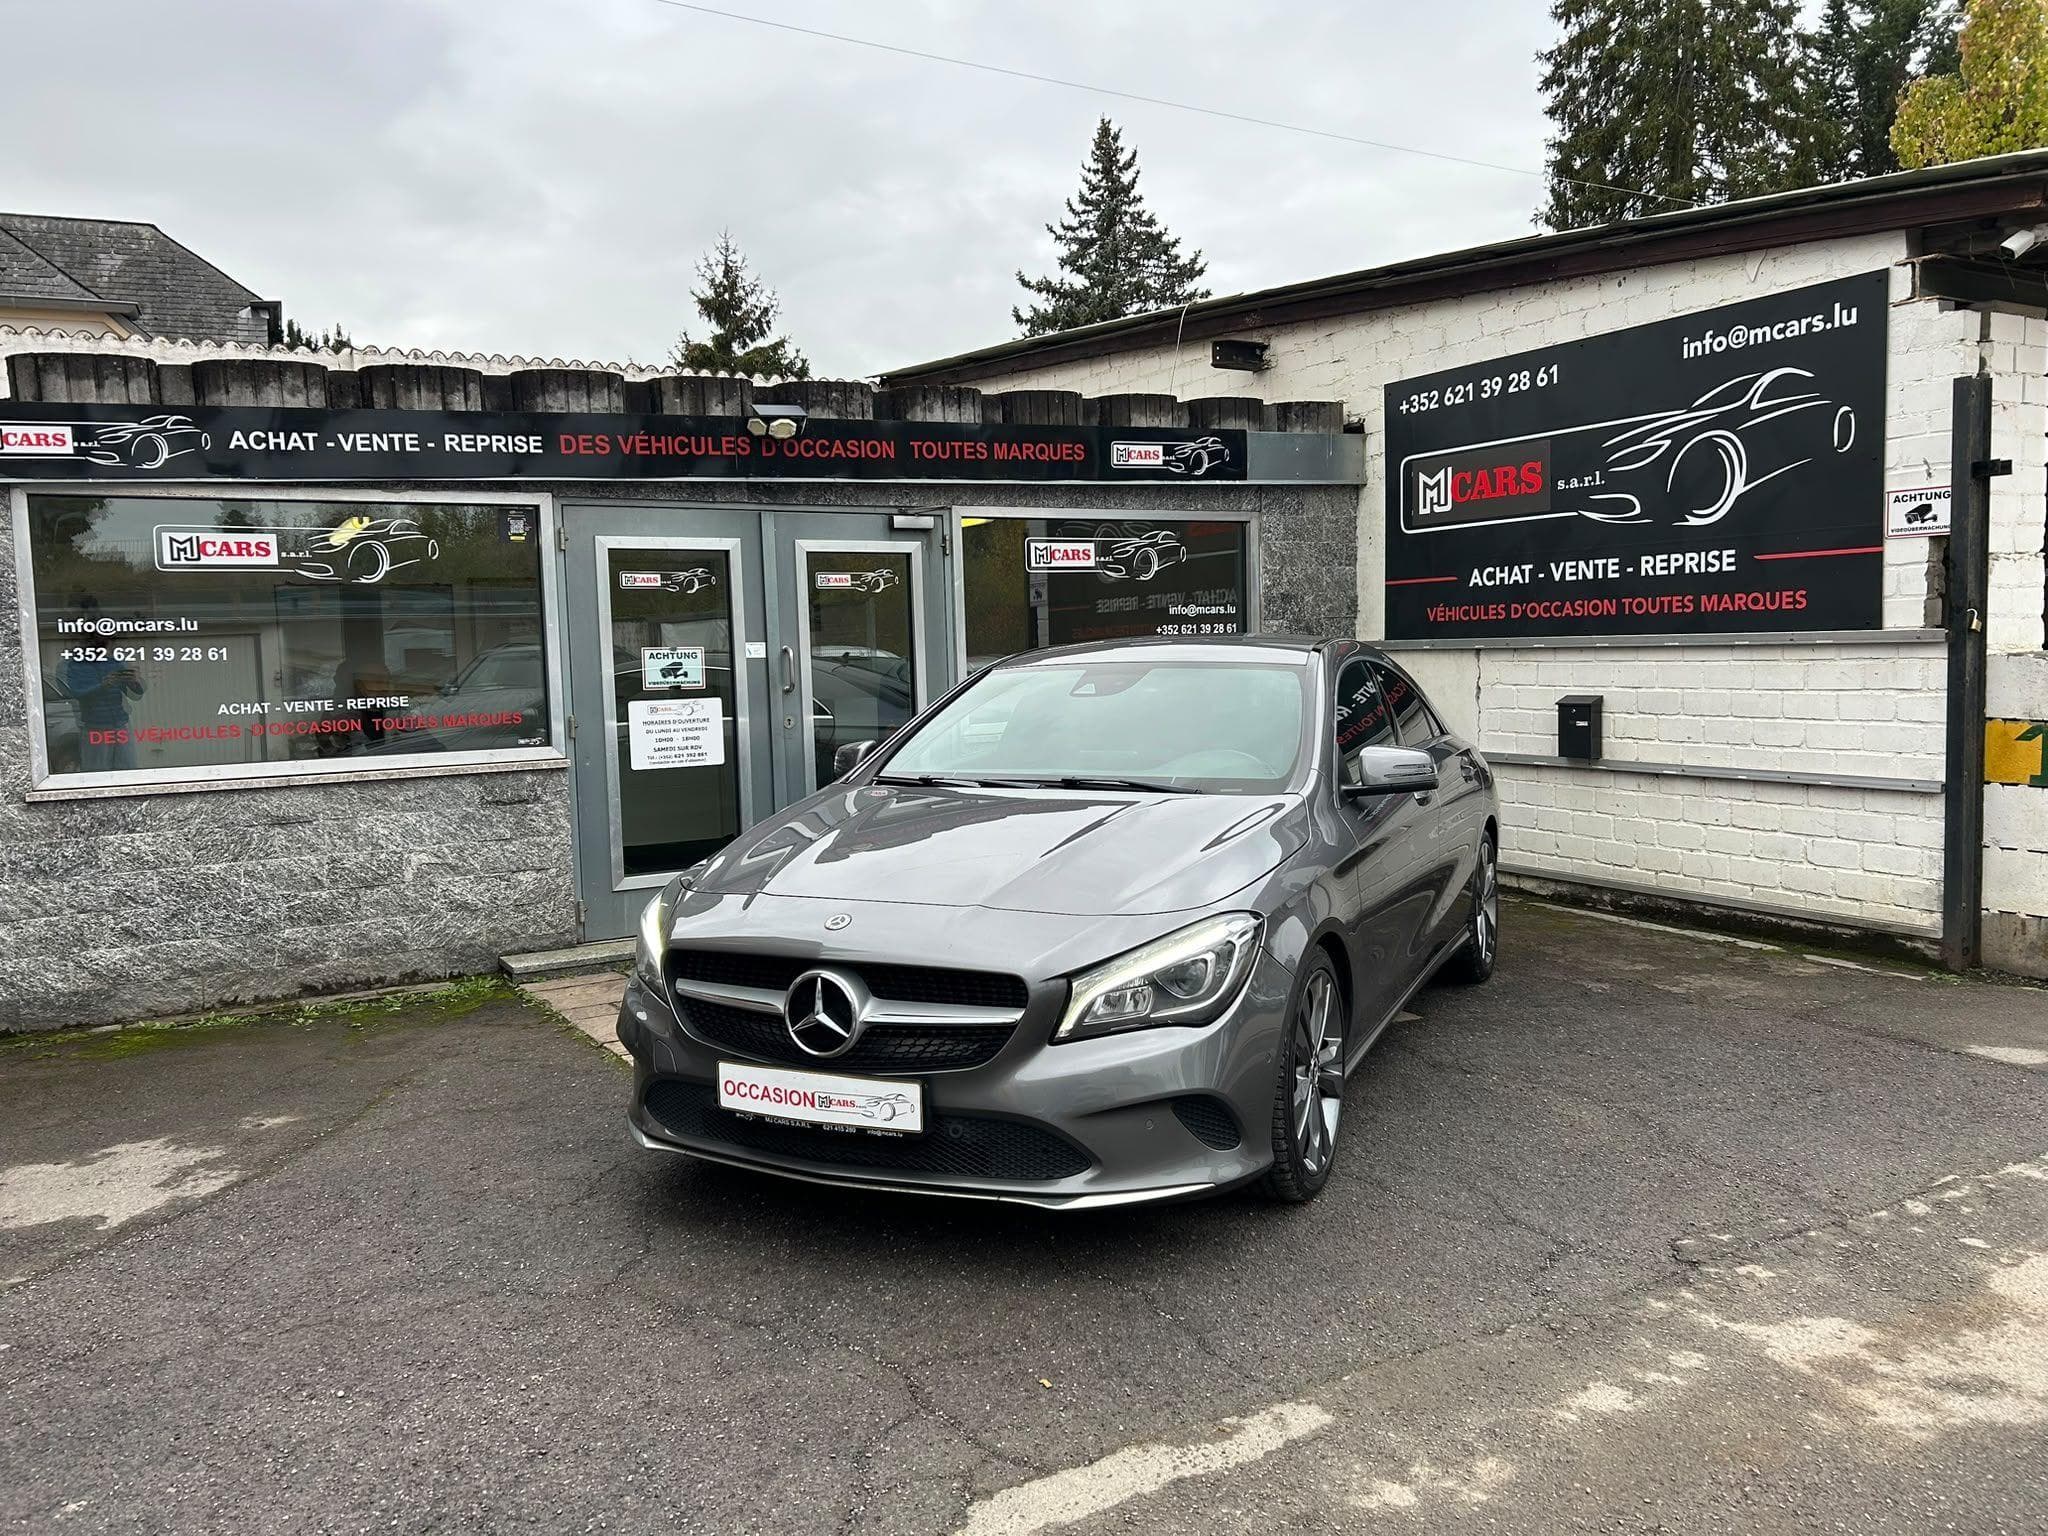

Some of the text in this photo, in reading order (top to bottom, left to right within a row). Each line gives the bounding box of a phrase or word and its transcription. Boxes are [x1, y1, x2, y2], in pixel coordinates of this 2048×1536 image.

[1682, 302, 1858, 359] info@mcars.lu
[1400, 364, 1558, 414] +352 621 39 28 61
[228, 430, 319, 451] ACHAT
[337, 433, 421, 452] VENTE
[444, 434, 543, 453] REPRISE
[559, 434, 611, 455] DES
[616, 431, 750, 456] VÉHICULES
[761, 439, 895, 458] D'OCCASION
[909, 441, 988, 459] TOUTES
[993, 442, 1085, 461] MARQUES
[1557, 471, 1606, 490] s.a.r.l.
[1893, 490, 1951, 503] ACHTUNG
[281, 550, 313, 558] s.a.r.l.
[1469, 564, 1533, 587] ACHAT
[1550, 558, 1620, 582] VENTE
[1640, 549, 1737, 577] REPRISE
[1169, 604, 1236, 617] info@mcars.lu
[1427, 590, 1807, 622] VÉHICULES D'OCCASION TOUTES MARQUES
[57, 617, 199, 636] info@mcars.lu
[1156, 624, 1178, 635] +352
[1181, 624, 1197, 635] 621
[1200, 624, 1211, 634] 39
[1213, 624, 1225, 634] 28
[1226, 623, 1237, 633] 61
[60, 647, 228, 662] +352 621 39 28 61
[649, 652, 698, 660] ACHTUNG
[217, 702, 271, 715] ACHAT
[283, 700, 334, 713] VENTE
[347, 696, 409, 710] REPRISE
[89, 711, 522, 745] DES VÉHICULES D'OCCASION TOUTES MARQUES
[724, 1080, 815, 1108] OCCASION
